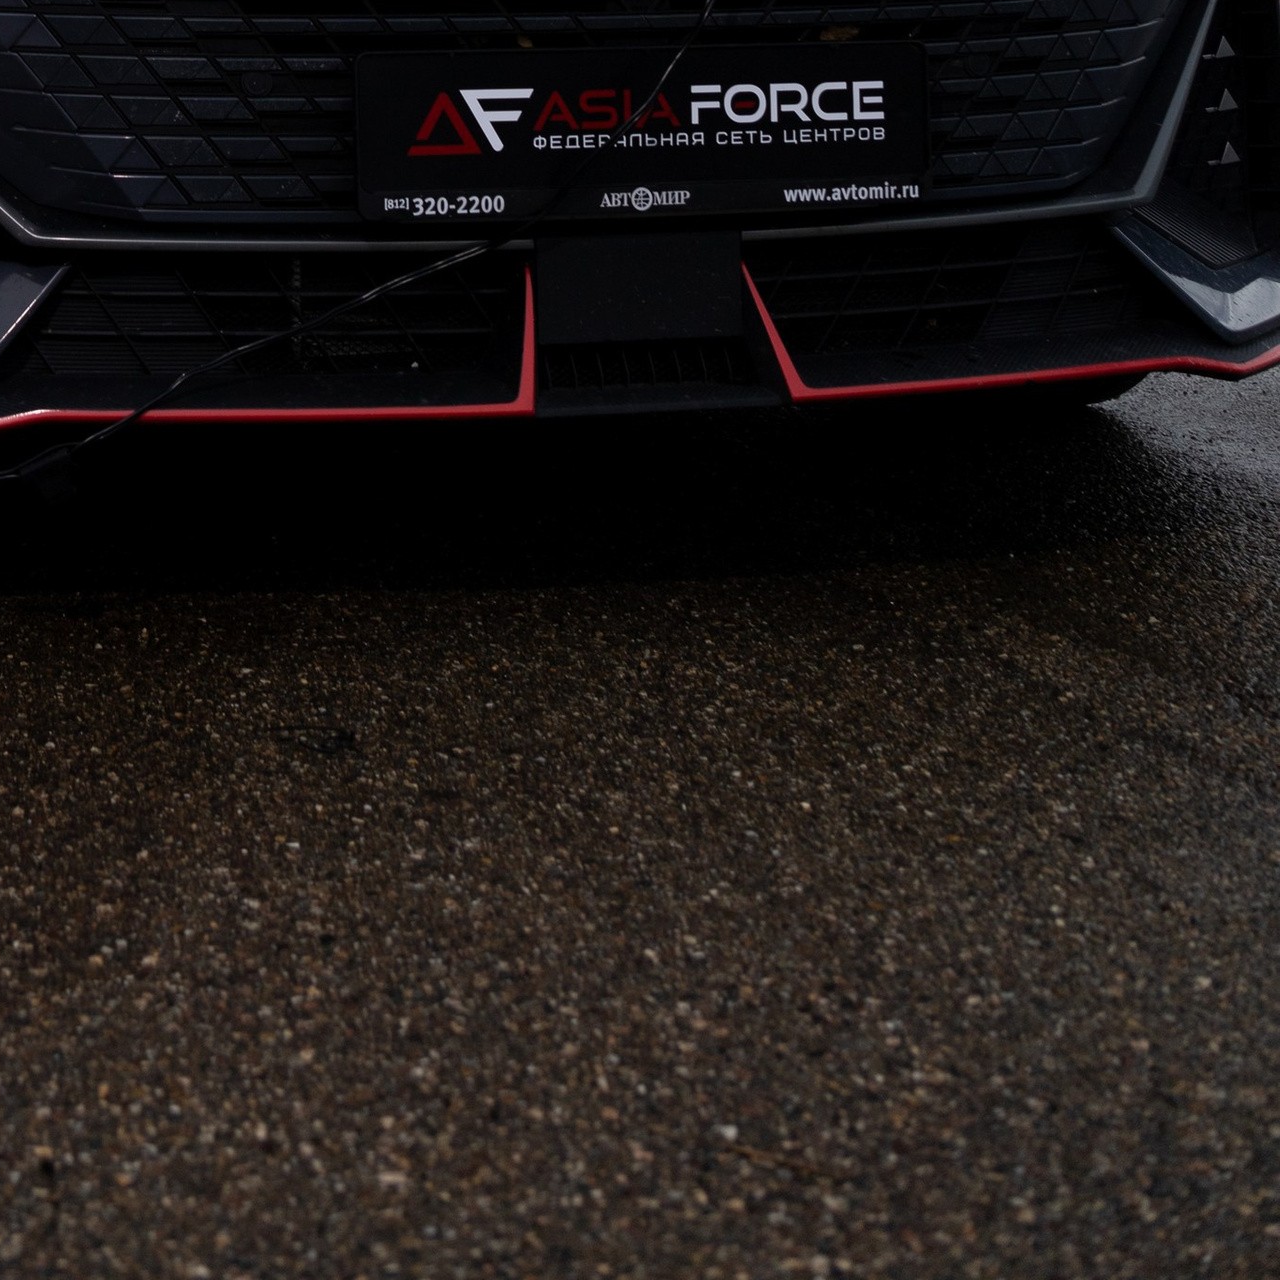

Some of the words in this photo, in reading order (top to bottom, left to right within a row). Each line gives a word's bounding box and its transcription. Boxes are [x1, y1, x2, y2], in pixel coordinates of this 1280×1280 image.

[533, 88, 681, 131] ASIA
[691, 81, 884, 125] FORCE
[716, 129, 773, 146] СЕТЬ
[783, 126, 885, 144] ЦЕНТРОВ
[783, 181, 920, 204] www.avtomir.ru
[412, 194, 505, 216] 320-2200
